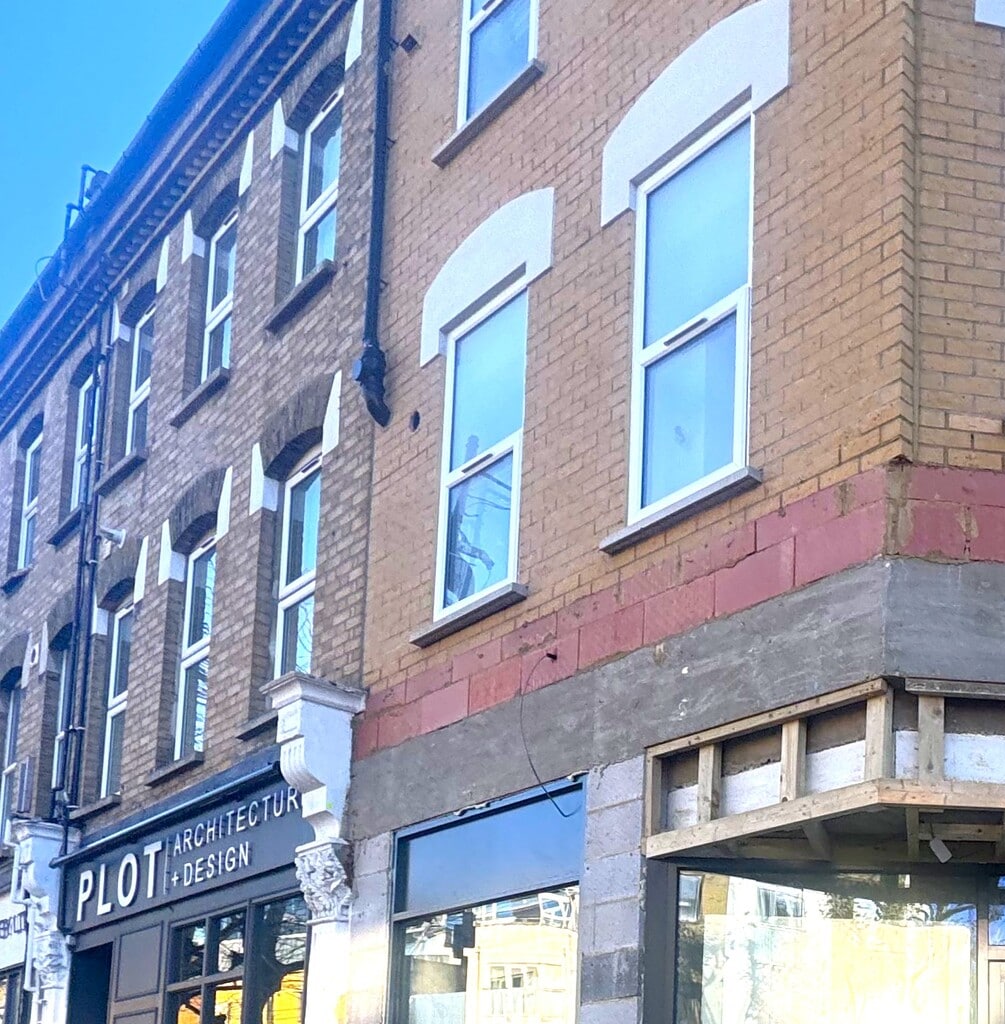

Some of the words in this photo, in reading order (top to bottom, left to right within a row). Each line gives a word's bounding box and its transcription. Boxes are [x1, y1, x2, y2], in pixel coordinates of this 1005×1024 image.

[173, 786, 299, 857] ARCHITECTUR
[76, 840, 162, 922] PLOT
[183, 841, 250, 887] DESIGN
